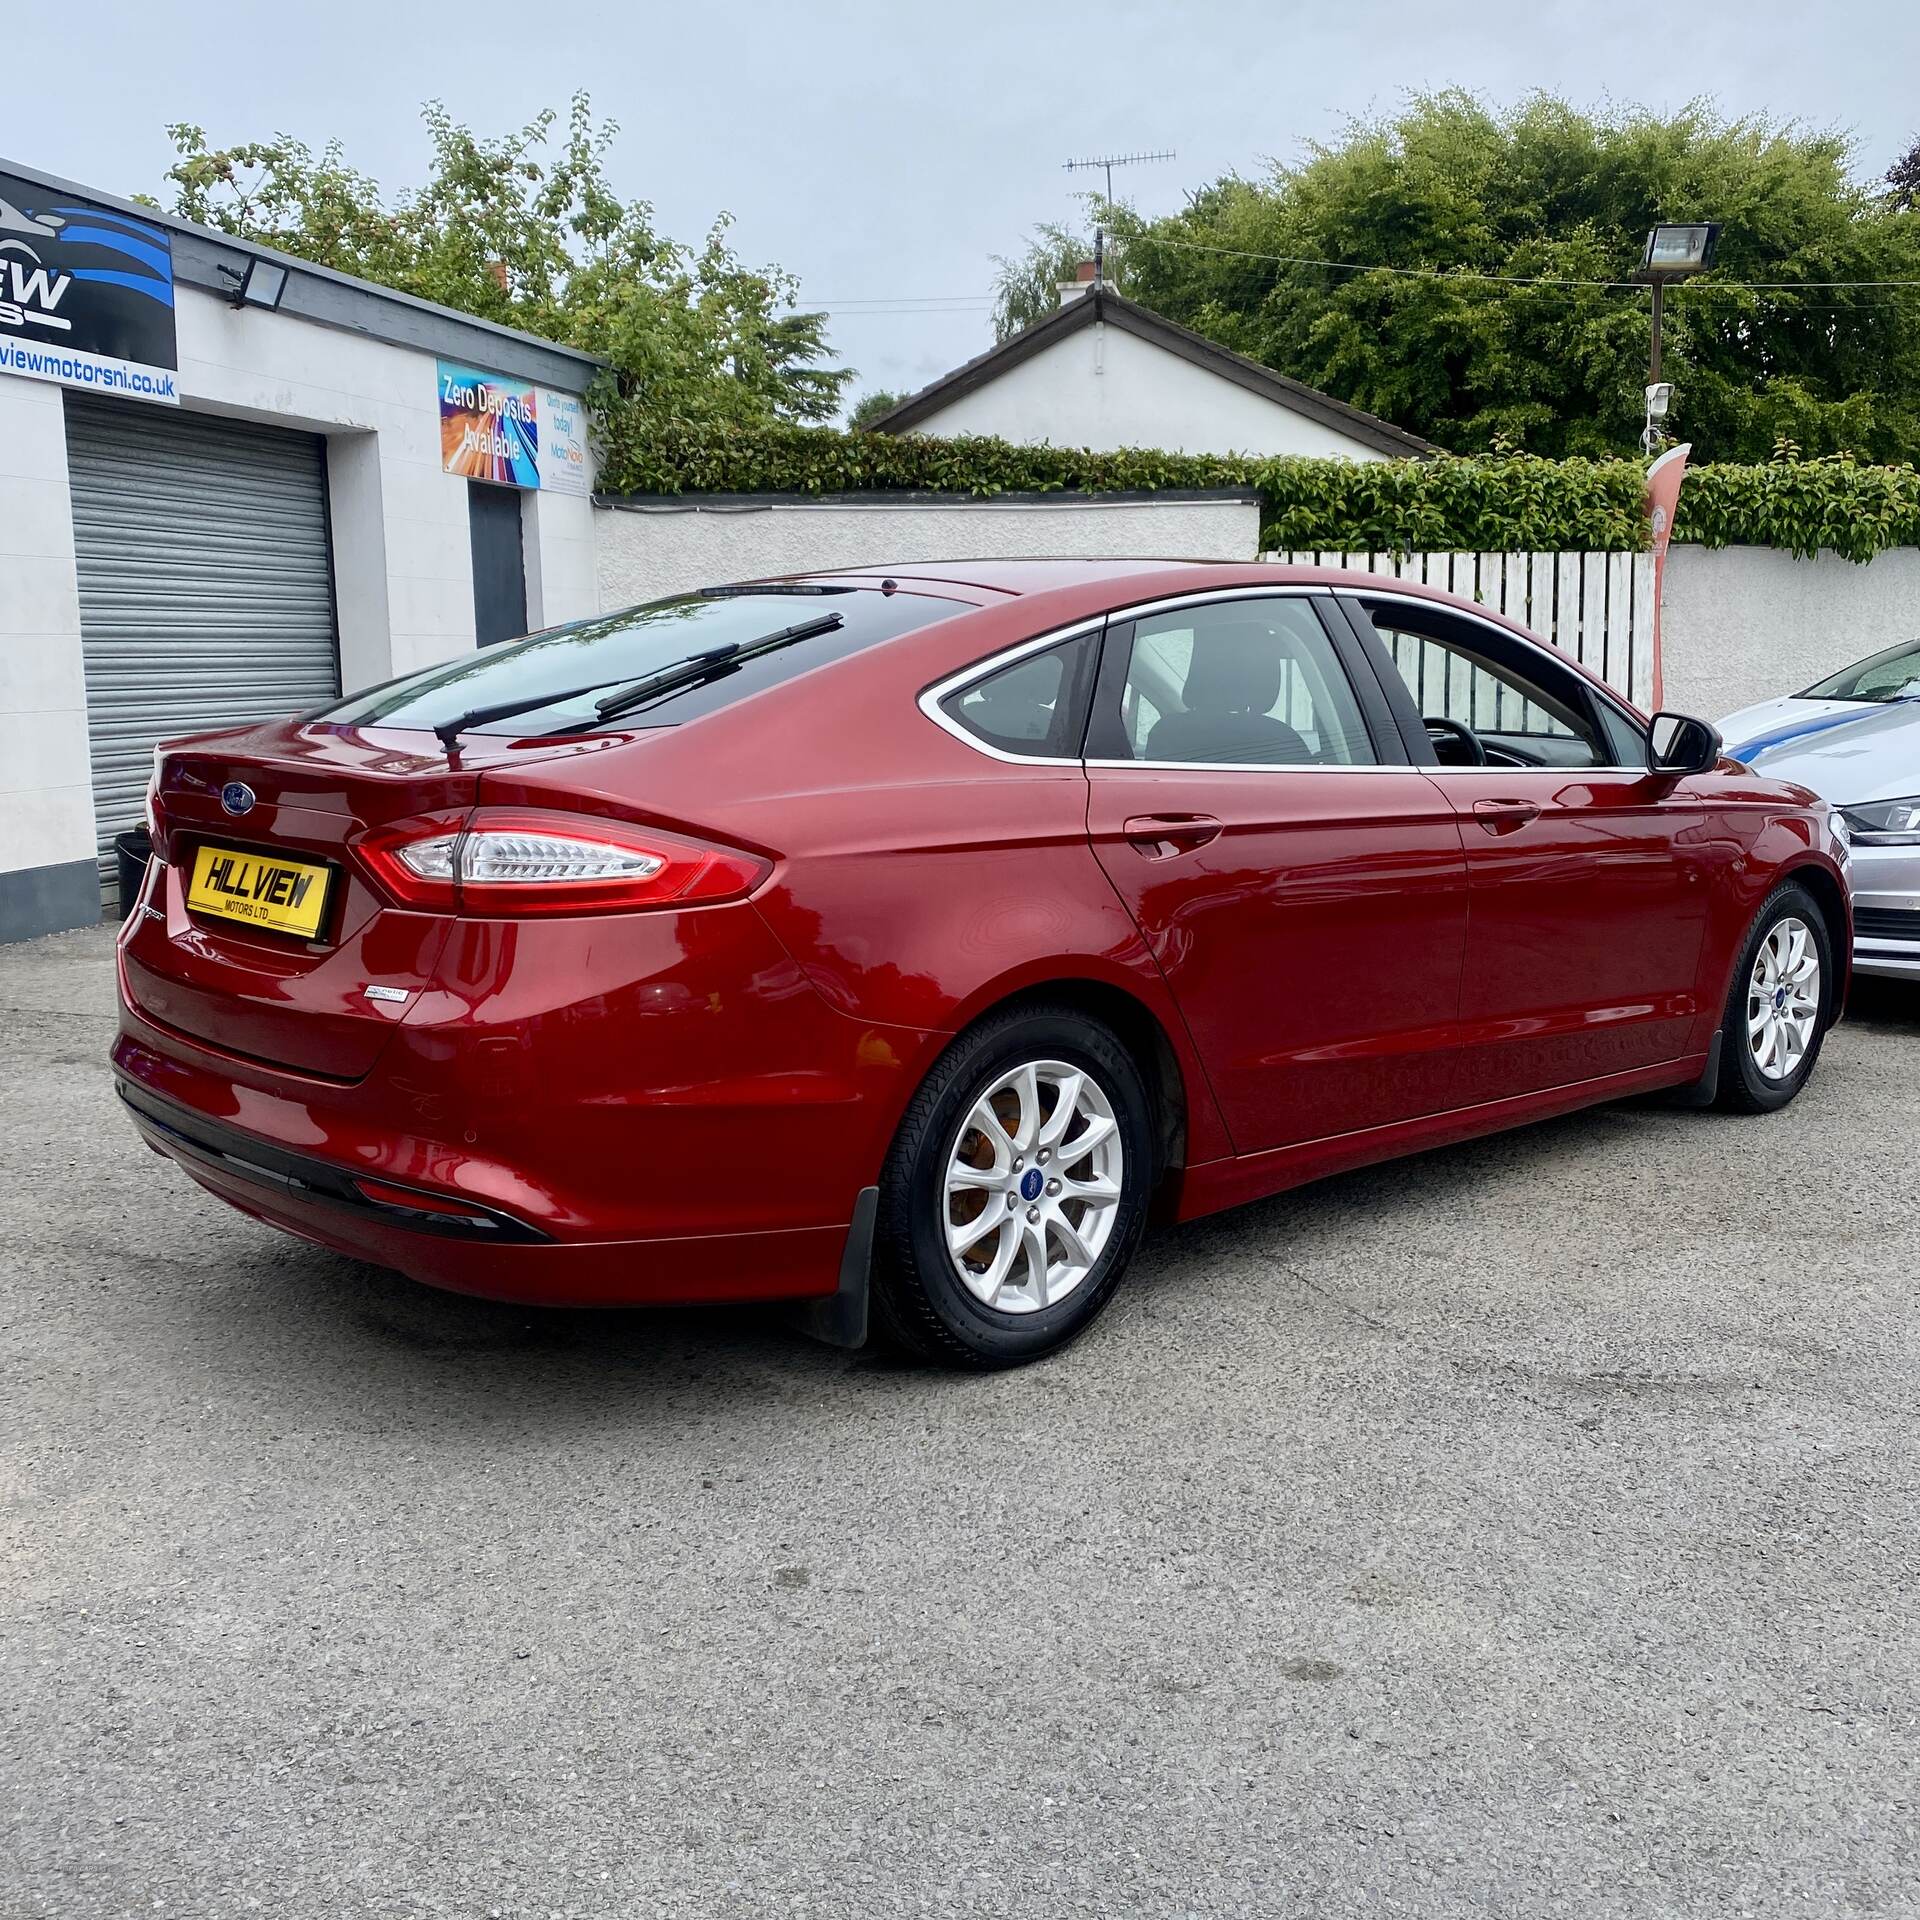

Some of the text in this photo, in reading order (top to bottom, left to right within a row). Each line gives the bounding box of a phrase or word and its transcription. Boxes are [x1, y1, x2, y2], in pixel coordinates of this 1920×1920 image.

[443, 374, 532, 423] Zero Deposits
[463, 422, 520, 460] Available
[225, 899, 269, 920] MOTORS LTD
